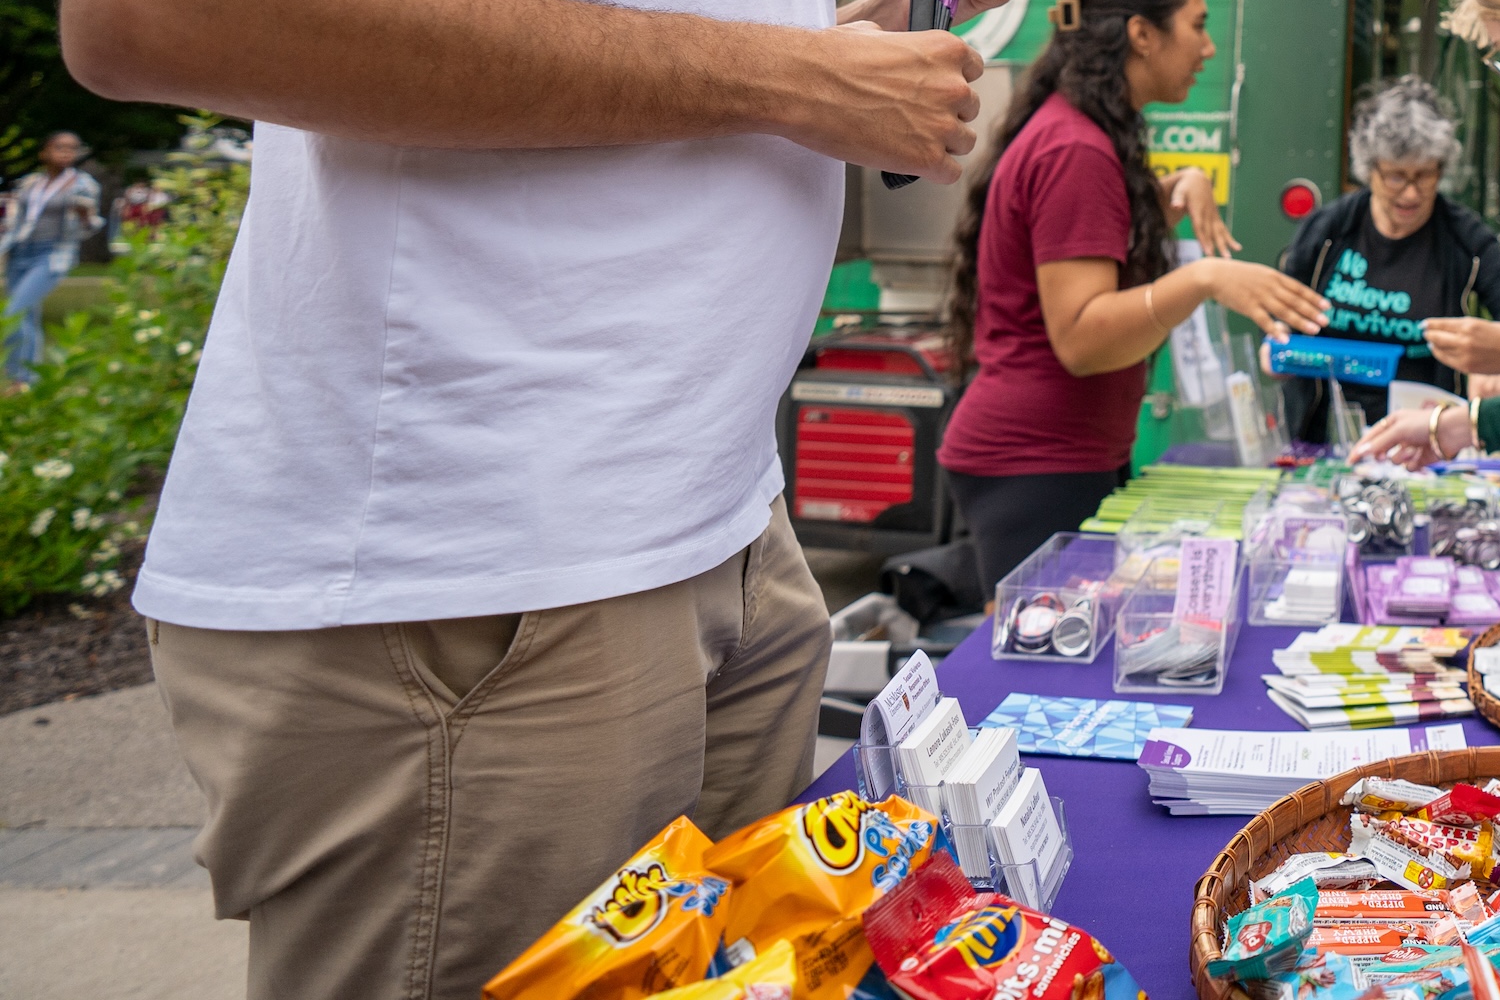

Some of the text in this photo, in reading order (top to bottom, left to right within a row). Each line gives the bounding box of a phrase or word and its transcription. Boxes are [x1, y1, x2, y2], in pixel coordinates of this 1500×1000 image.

[1324, 273, 1411, 314] Believe
[1322, 306, 1423, 341] urvivor
[926, 738, 941, 757] Lenore
[1398, 828, 1460, 850] CRISP
[1399, 820, 1480, 842] COFFEE
[1360, 892, 1402, 900] CHEWY
[1367, 900, 1405, 908] DIPPED
[1332, 928, 1377, 936] CHEWY
[1341, 935, 1381, 944] DIPPED
[1032, 932, 1081, 998] sandwiches
